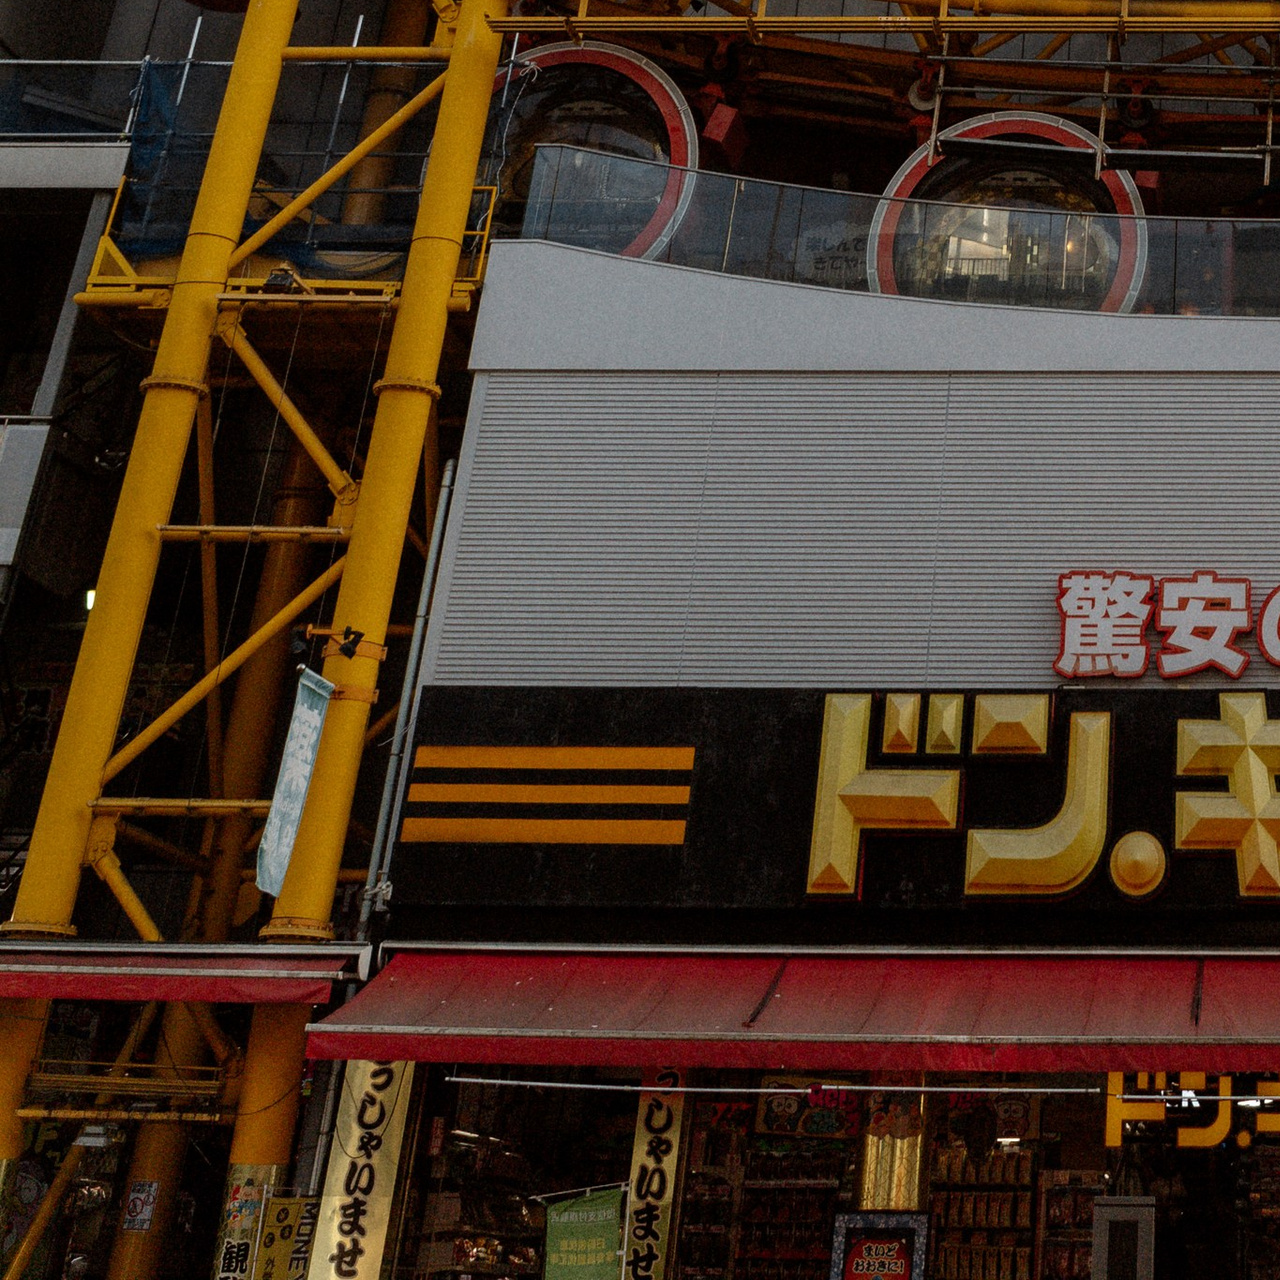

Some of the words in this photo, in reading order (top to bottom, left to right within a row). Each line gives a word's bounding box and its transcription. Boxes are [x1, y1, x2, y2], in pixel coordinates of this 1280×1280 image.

[329, 1059, 394, 1278] っしゃいませ
[626, 1066, 680, 1280] っしゃいませ
[219, 1240, 250, 1280] 観
[853, 1258, 905, 1274] おおきに!
[863, 1243, 899, 1258] まいど
